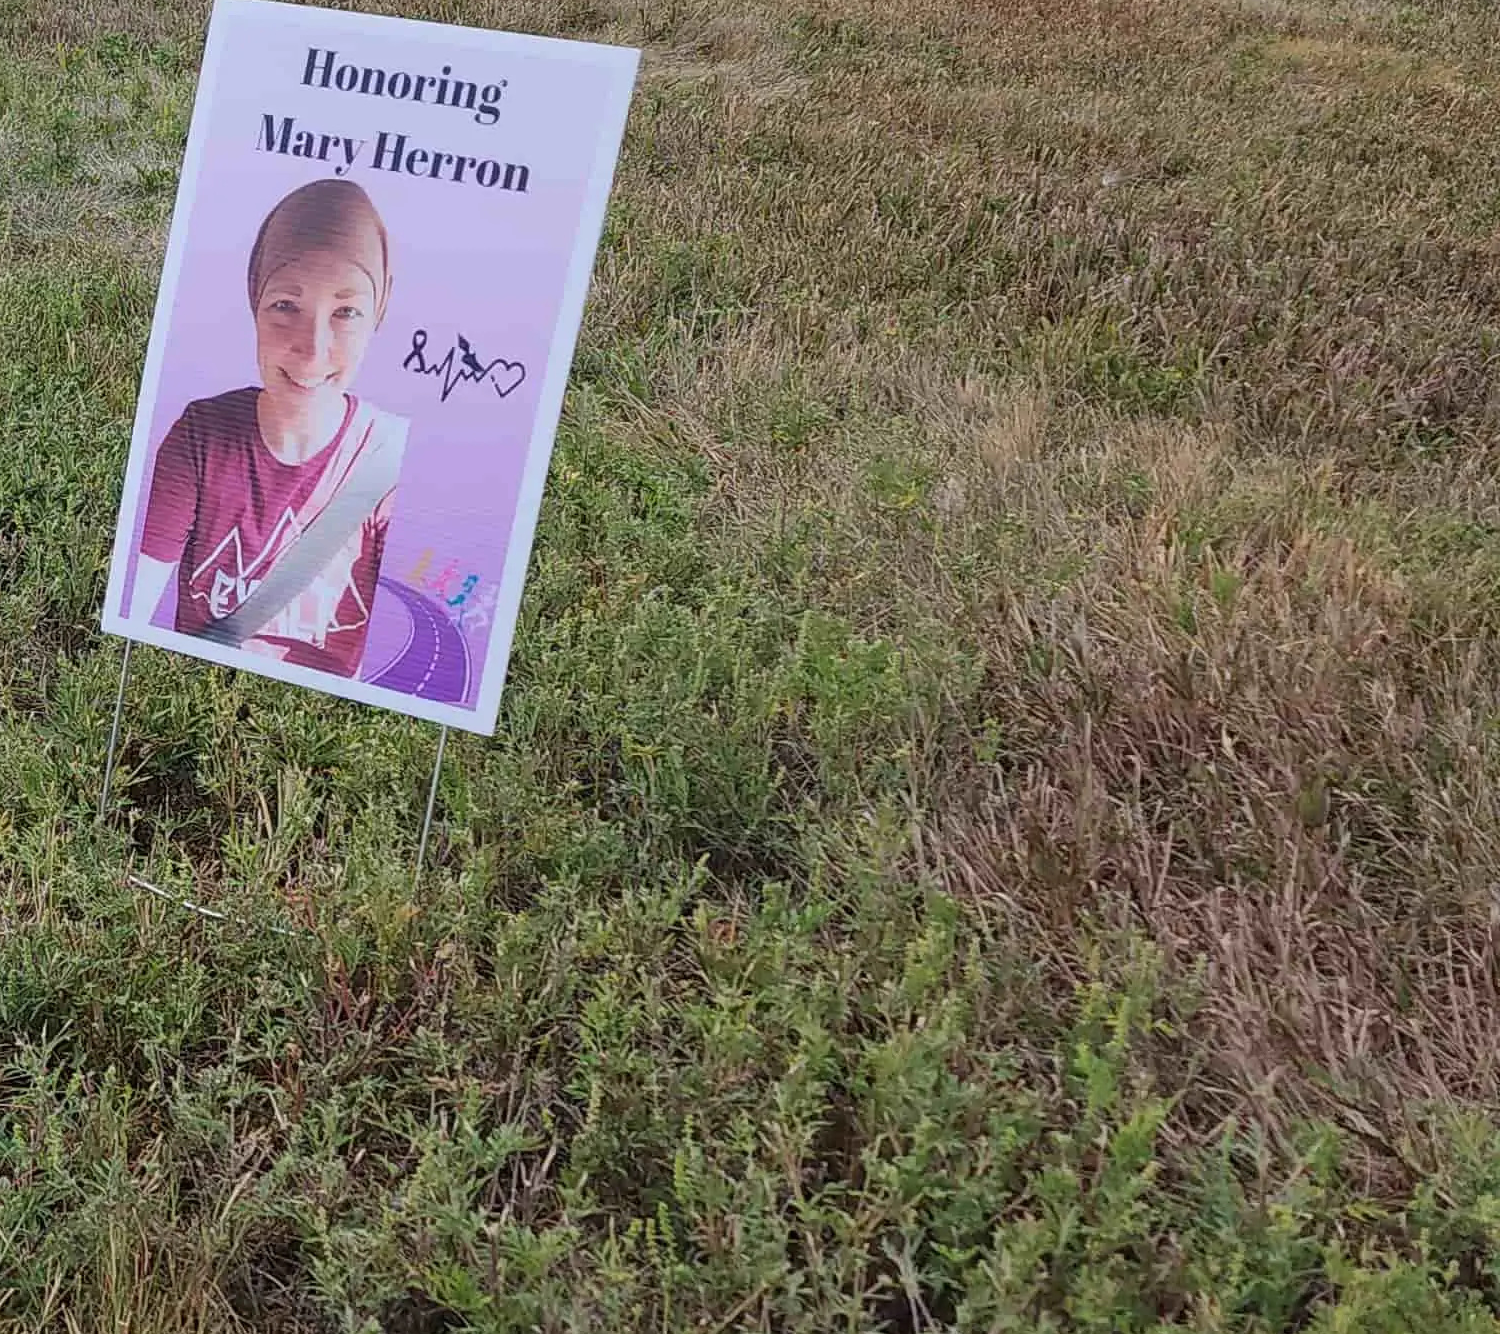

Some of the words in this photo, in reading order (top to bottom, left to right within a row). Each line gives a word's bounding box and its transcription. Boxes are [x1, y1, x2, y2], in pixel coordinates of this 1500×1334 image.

[300, 46, 508, 126] Honoring
[255, 112, 367, 177] Mary
[369, 130, 532, 194] Herron
